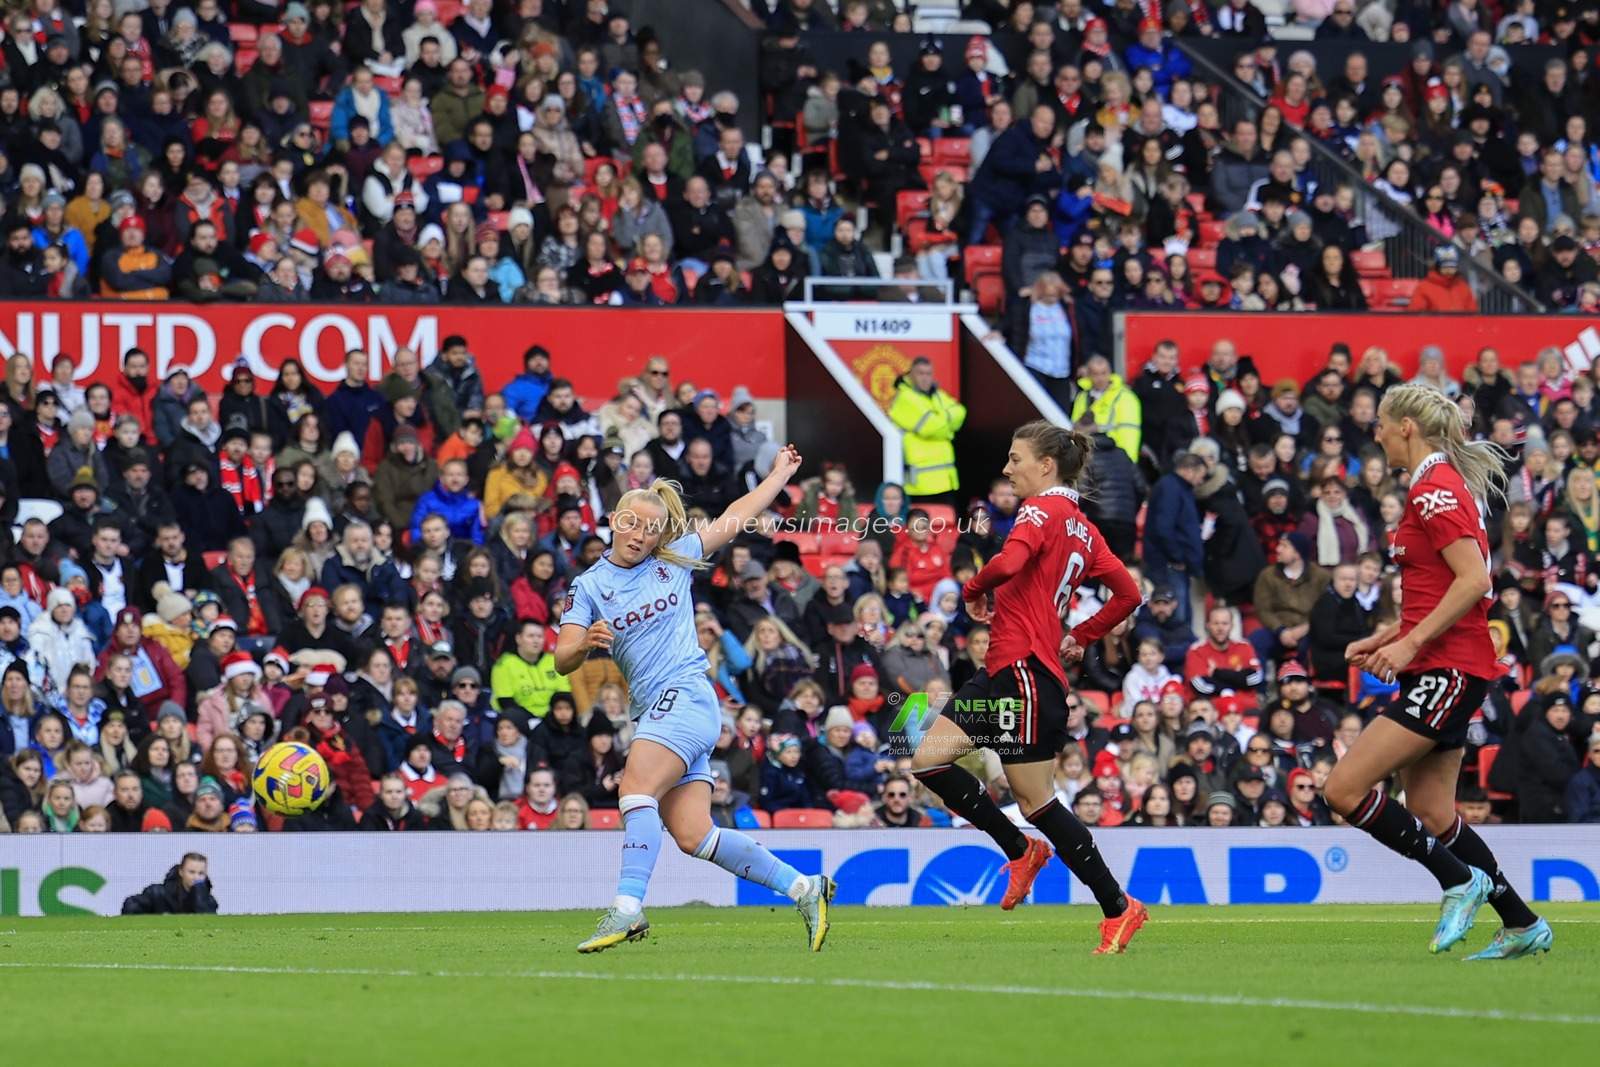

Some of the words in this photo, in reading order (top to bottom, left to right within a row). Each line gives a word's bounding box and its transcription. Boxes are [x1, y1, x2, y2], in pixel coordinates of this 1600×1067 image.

[855, 318, 911, 334] N1409
[1412, 489, 1458, 516] DXC
[1053, 551, 1085, 620] 6
[613, 593, 678, 631] CAZOO
[651, 688, 679, 712] 18
[999, 697, 1016, 731] 6
